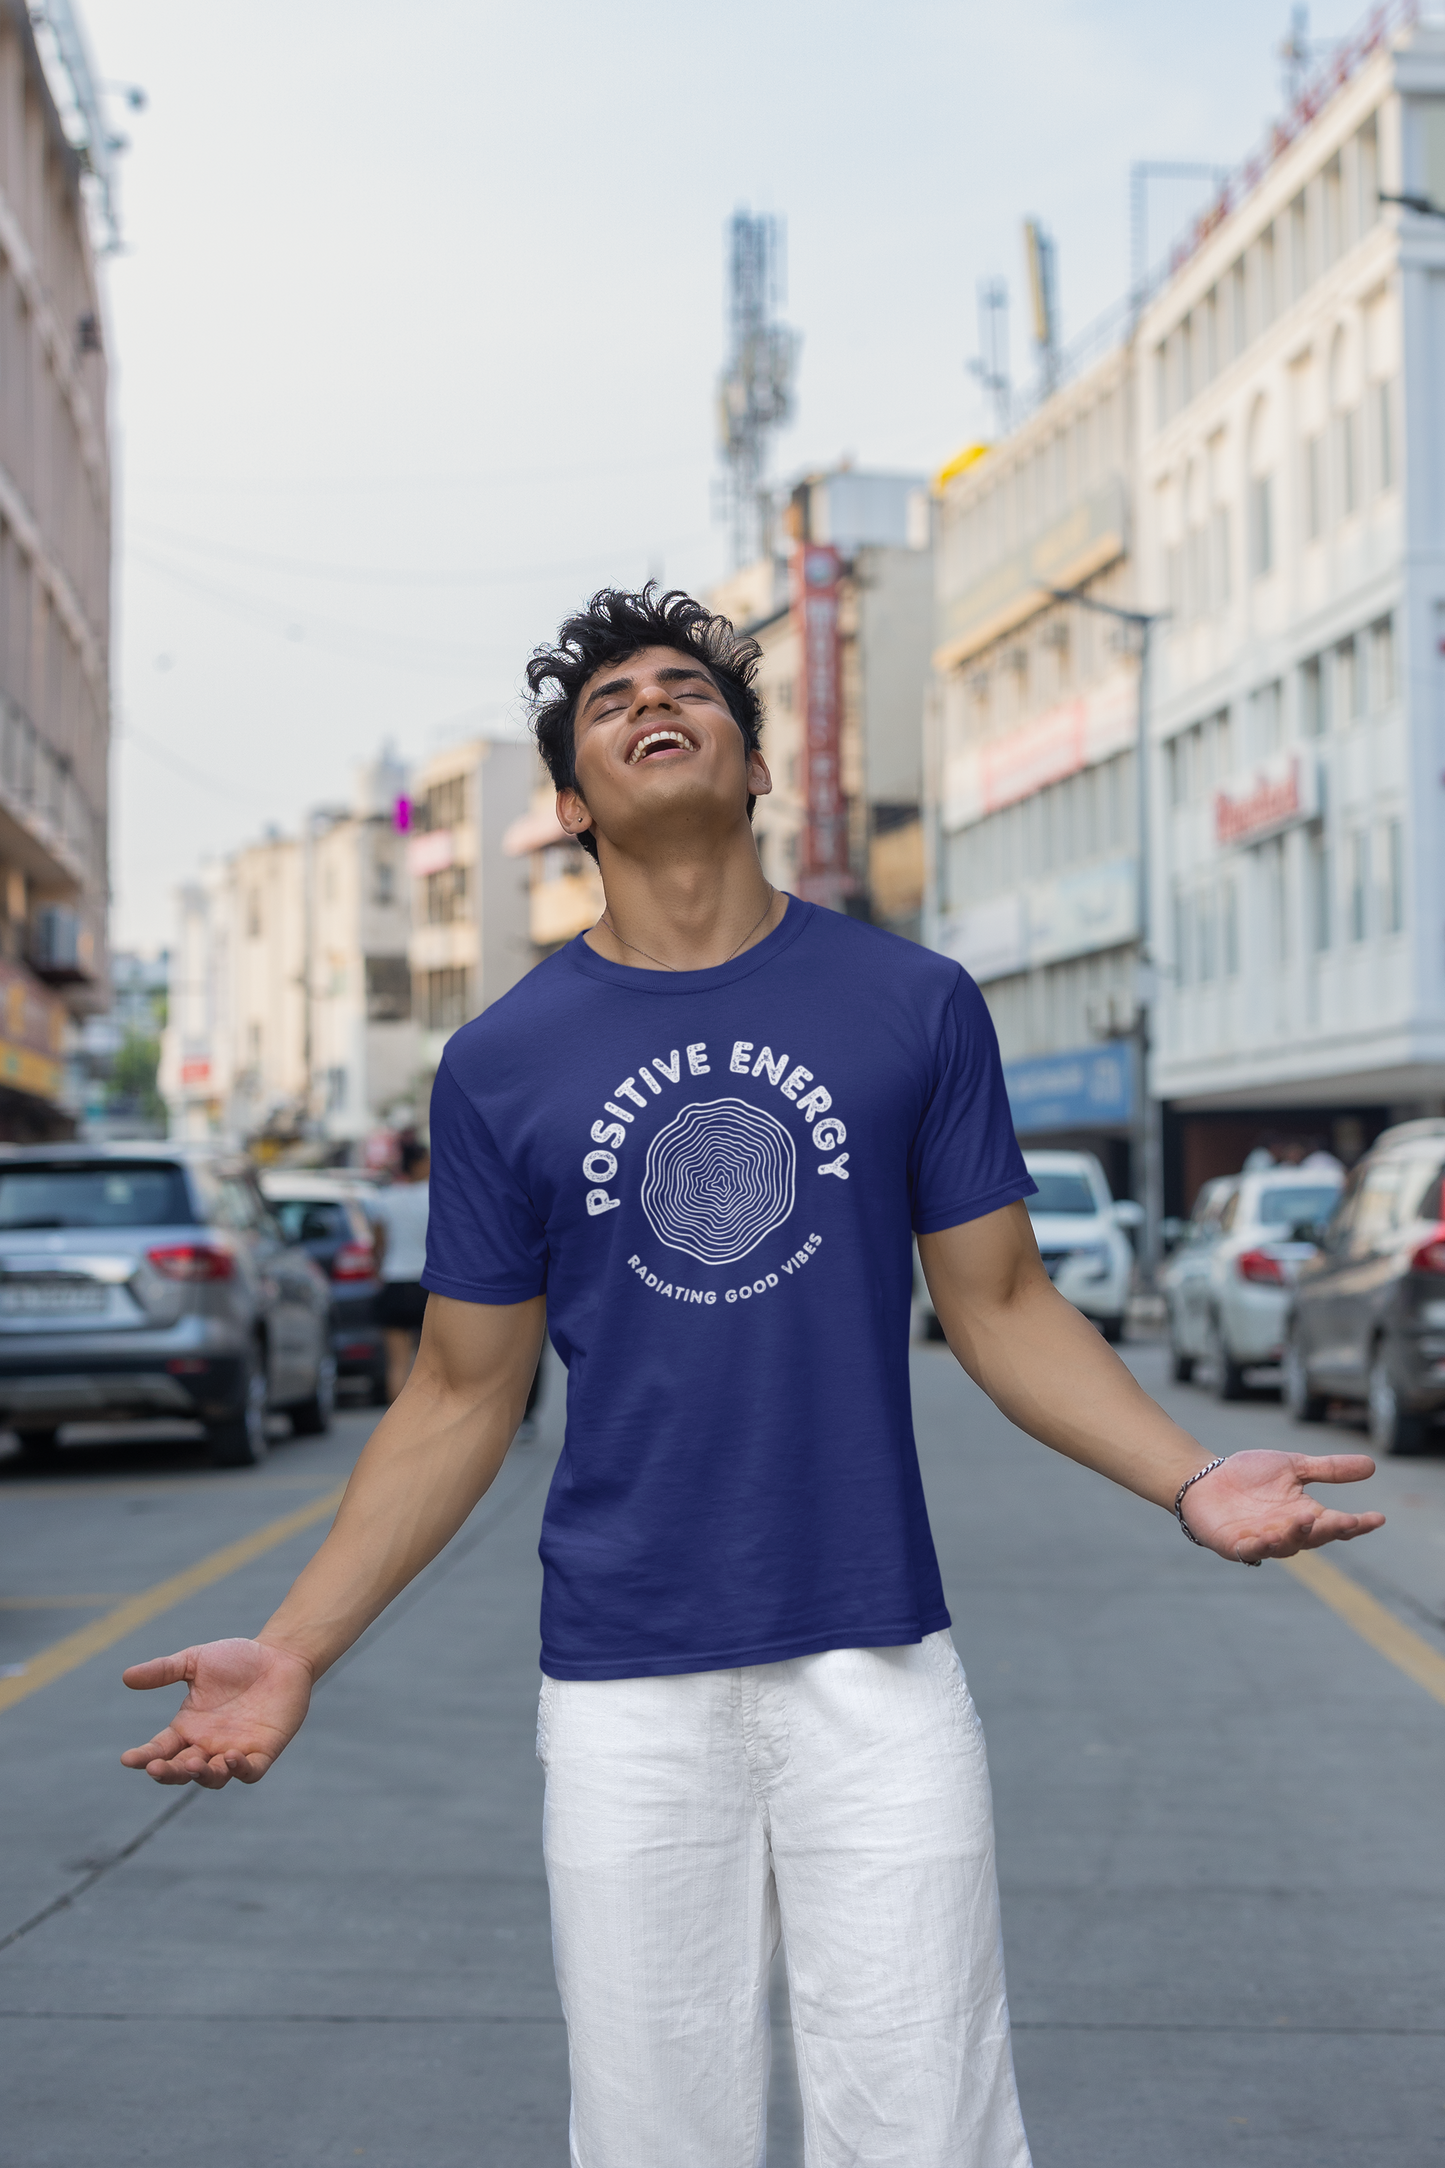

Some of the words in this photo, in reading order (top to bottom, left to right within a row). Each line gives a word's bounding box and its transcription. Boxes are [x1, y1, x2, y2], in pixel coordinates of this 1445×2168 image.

[582, 1042, 711, 1216] POSITIVE
[729, 1040, 850, 1180] ENERGY
[627, 1254, 717, 1305] RADIATING
[724, 1273, 779, 1303] GOOD
[780, 1232, 823, 1275] VIBES
